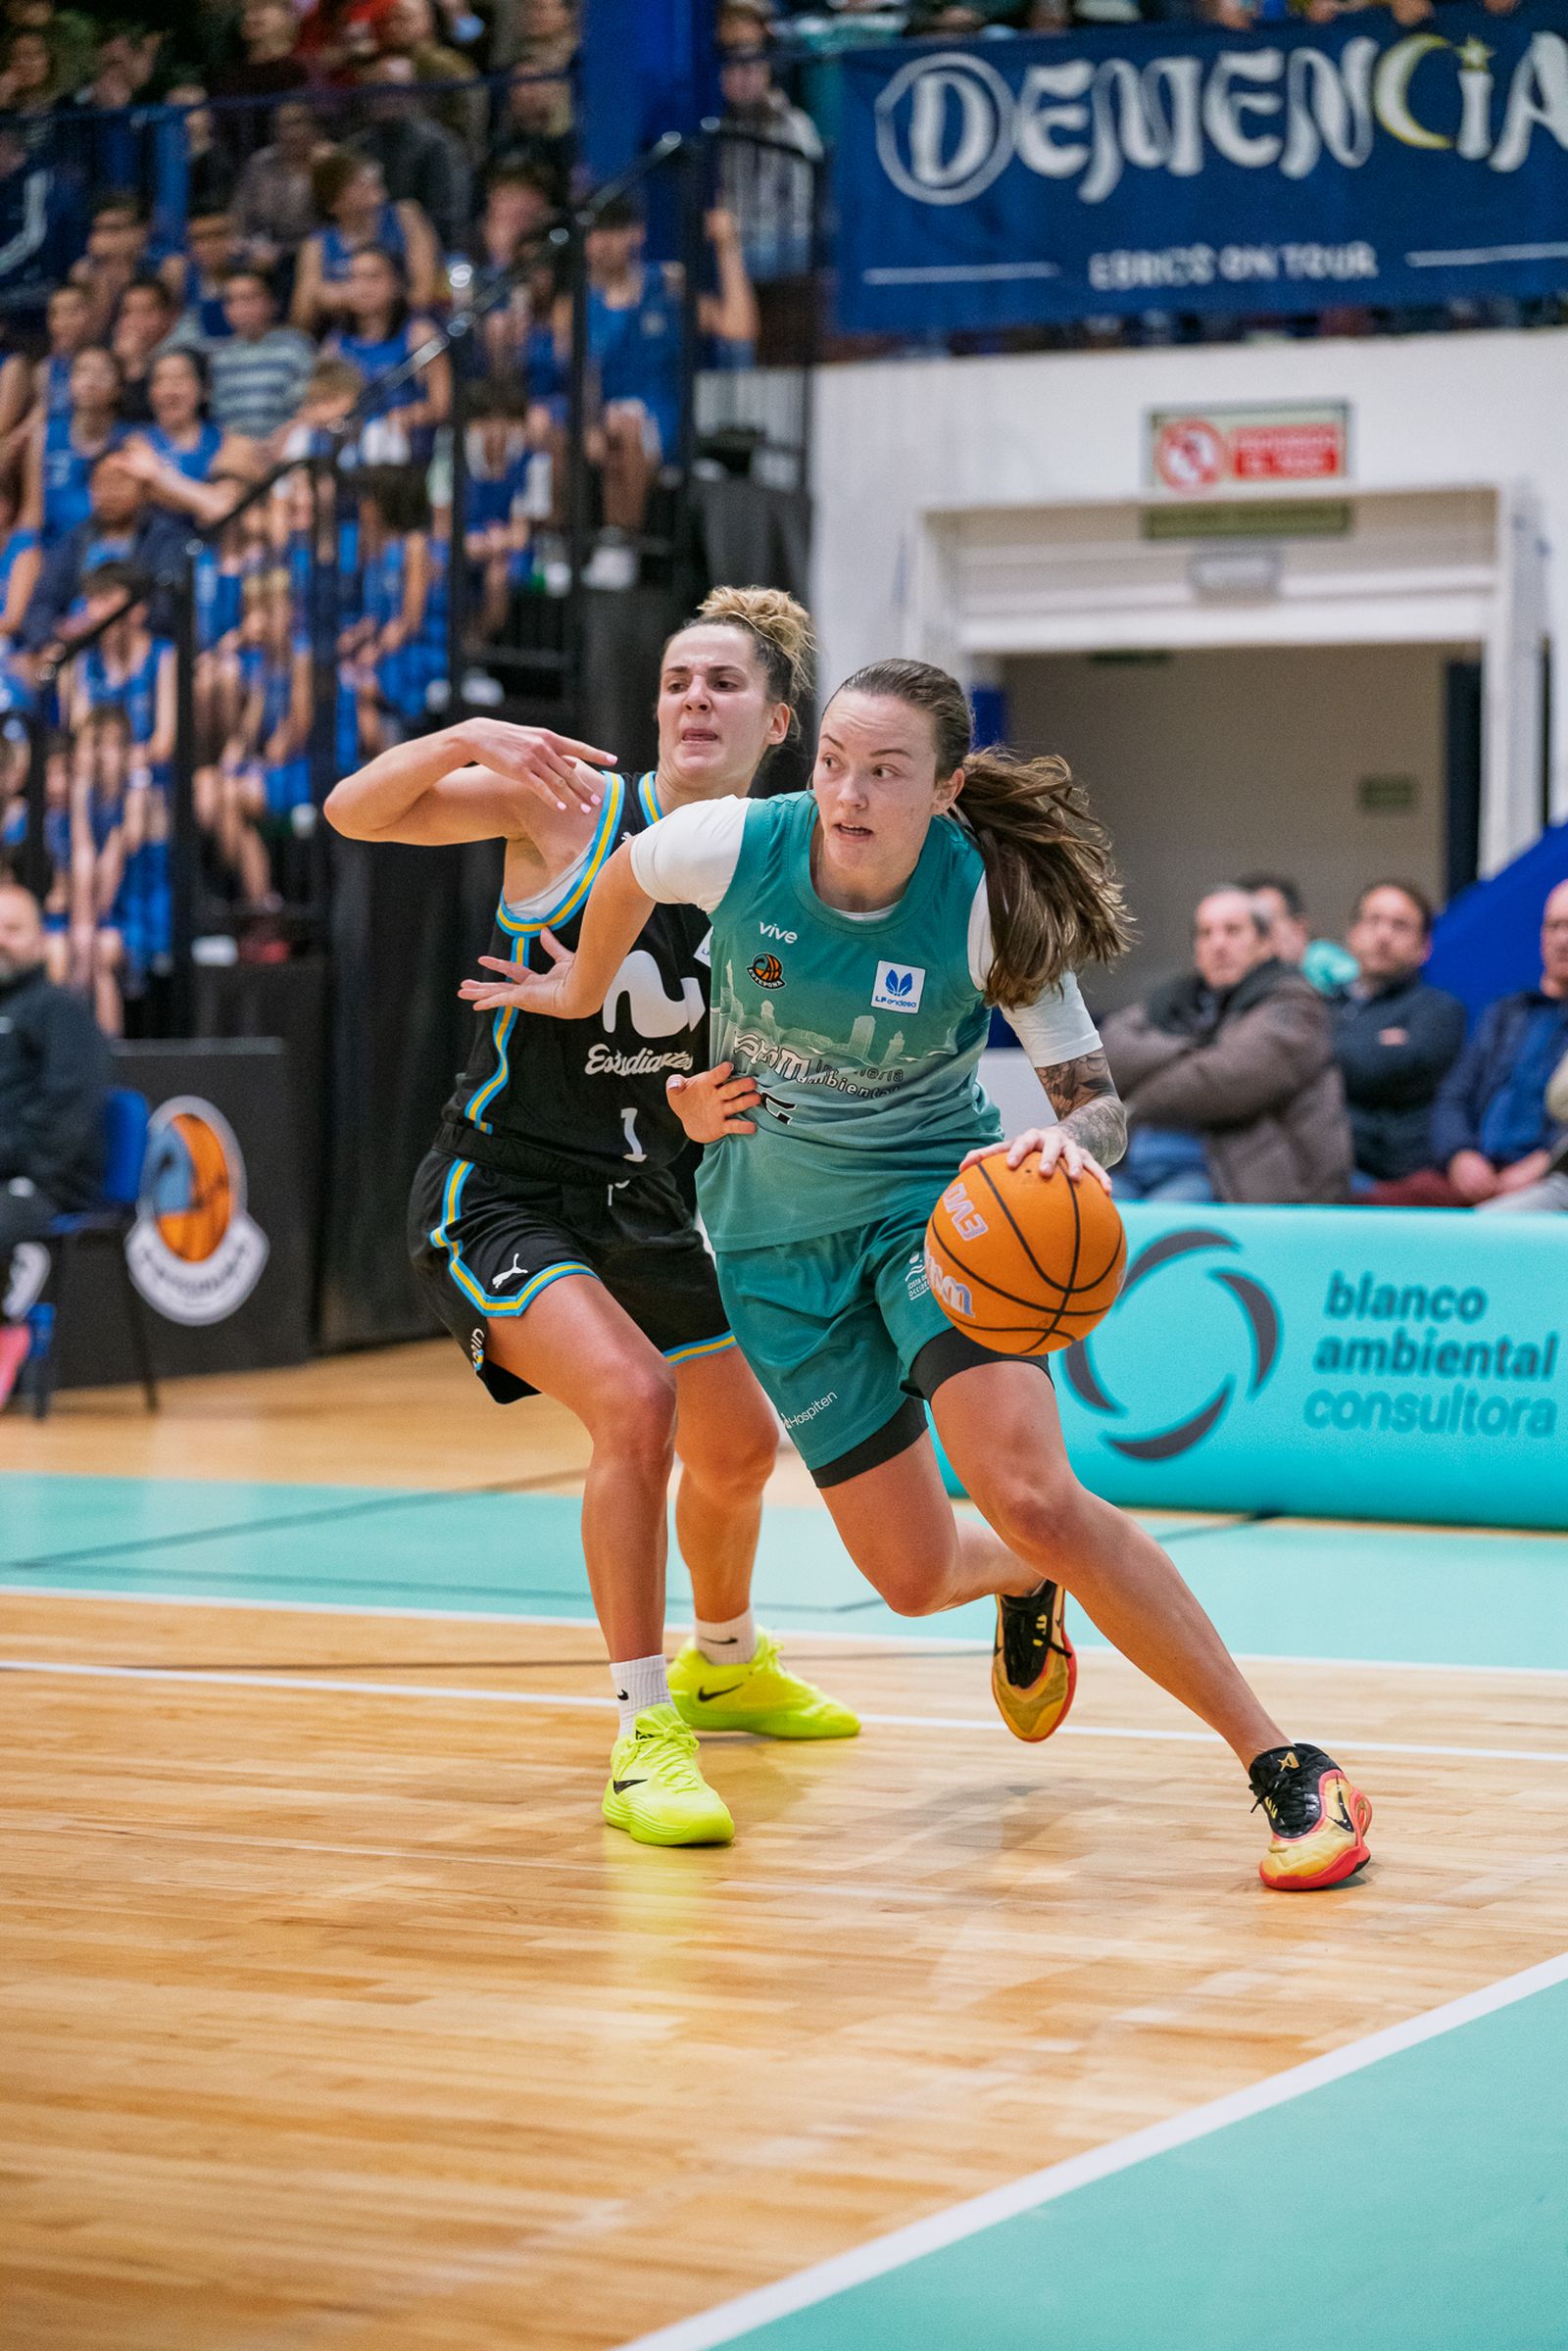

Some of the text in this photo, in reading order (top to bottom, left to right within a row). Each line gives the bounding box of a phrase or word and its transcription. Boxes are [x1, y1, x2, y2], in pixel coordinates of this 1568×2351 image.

[1220, 246, 1277, 280] ON
[1282, 242, 1378, 279] TOUR
[759, 921, 798, 944] vive
[620, 1107, 648, 1162] 1
[1326, 1270, 1488, 1322] blanco
[1313, 1326, 1560, 1381] ambiental
[788, 1391, 838, 1427] Hospiten
[1304, 1383, 1558, 1438] consultora
